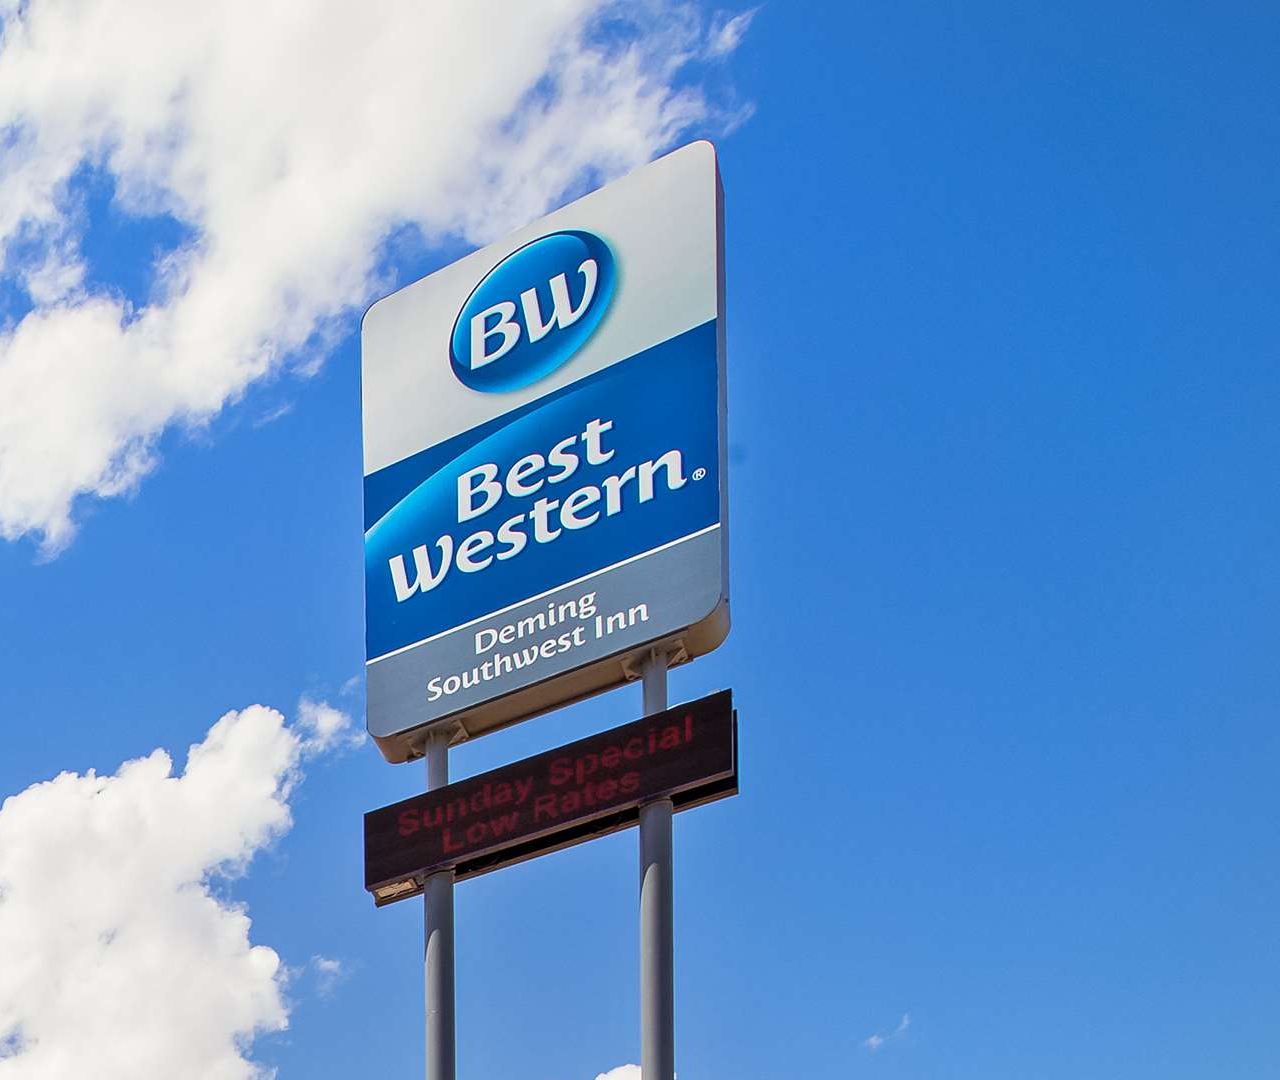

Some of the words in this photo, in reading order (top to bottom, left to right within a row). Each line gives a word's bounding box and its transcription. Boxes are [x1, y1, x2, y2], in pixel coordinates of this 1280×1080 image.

[470, 258, 598, 371] BW
[457, 418, 615, 524] Best
[426, 625, 587, 702] Southwest
[596, 603, 650, 639] Inn
[474, 592, 597, 655] Deming
[398, 776, 535, 837] Sunday
[548, 716, 692, 787] Special
[443, 812, 520, 852] Low
[533, 771, 641, 820] Rates
